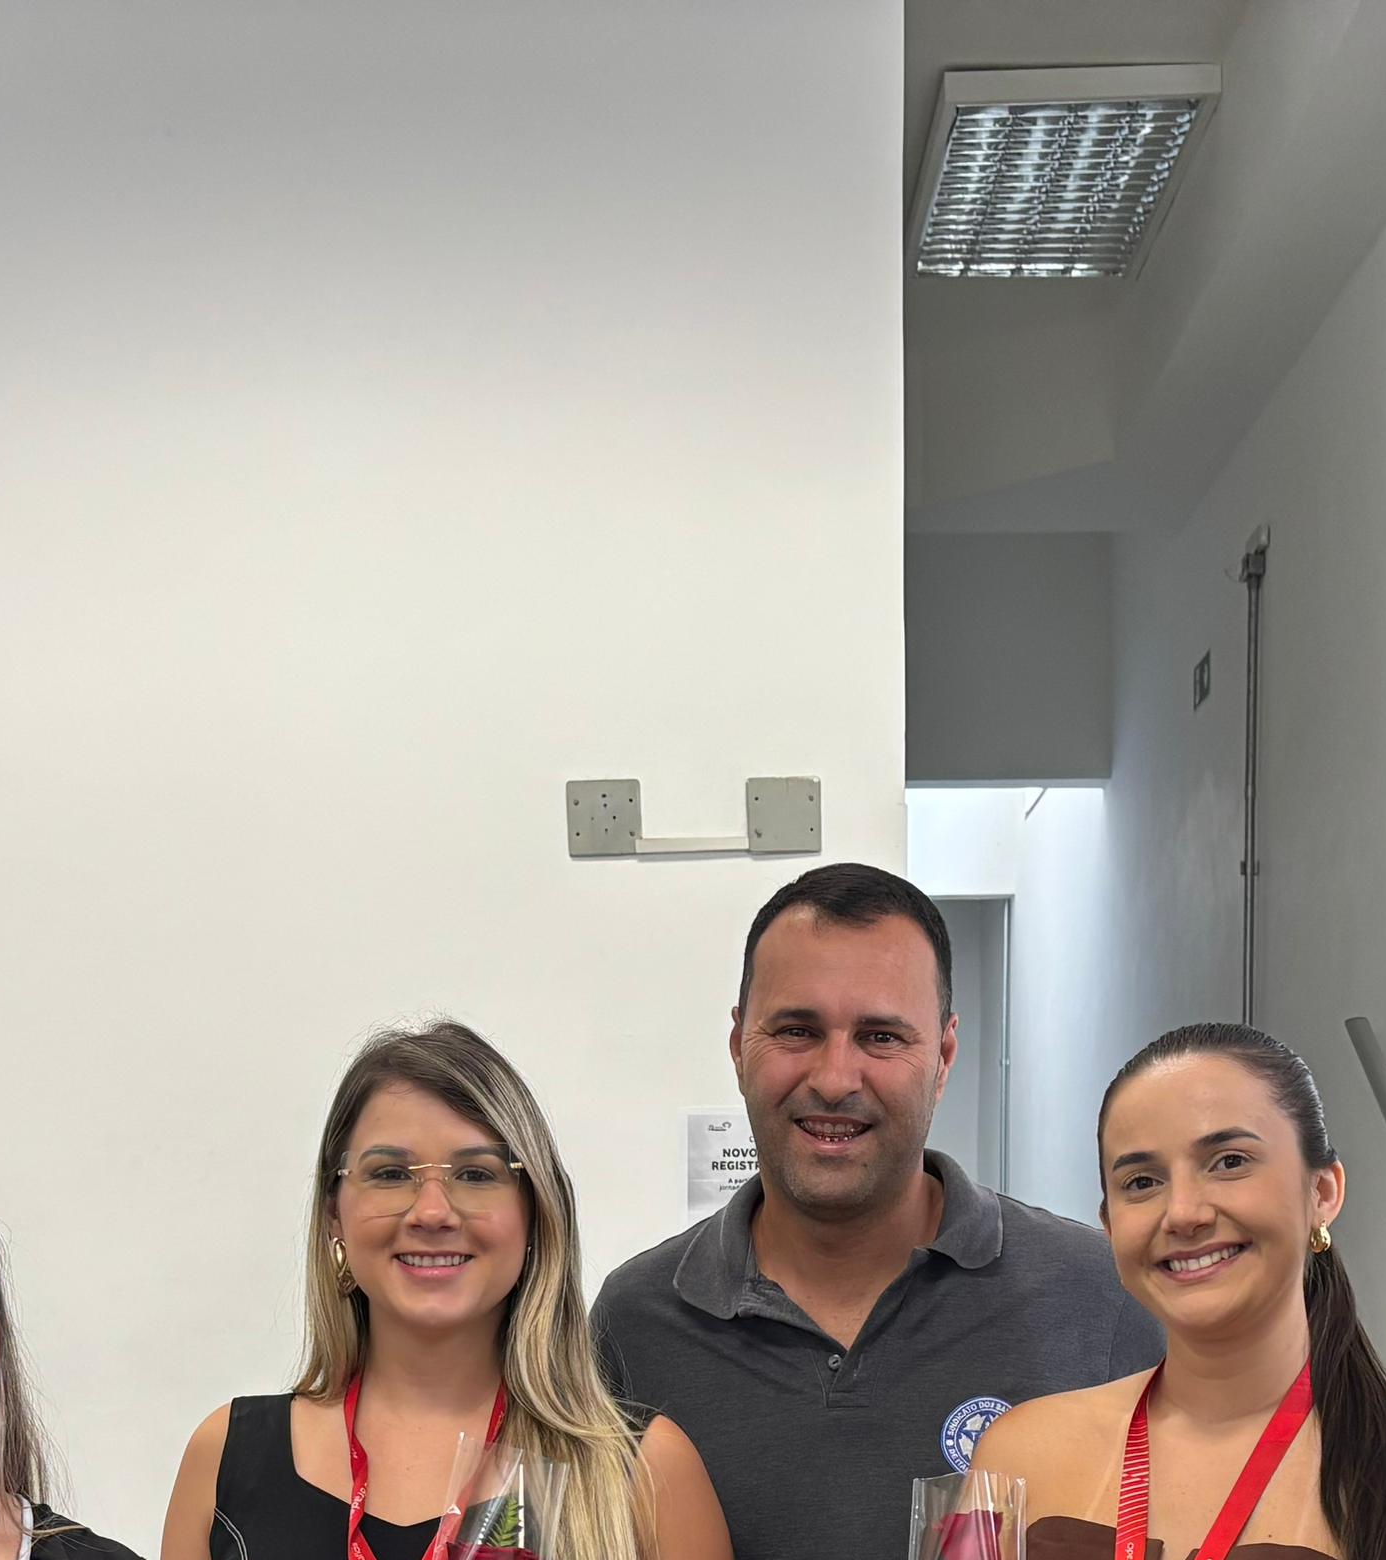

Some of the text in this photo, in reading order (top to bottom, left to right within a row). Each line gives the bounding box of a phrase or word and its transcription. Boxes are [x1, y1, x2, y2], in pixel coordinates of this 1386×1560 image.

[723, 1148, 757, 1158] NOVO
[947, 1403, 977, 1436] SINDICATO
[978, 1401, 994, 1409] DOS
[953, 1458, 968, 1472] ITA
